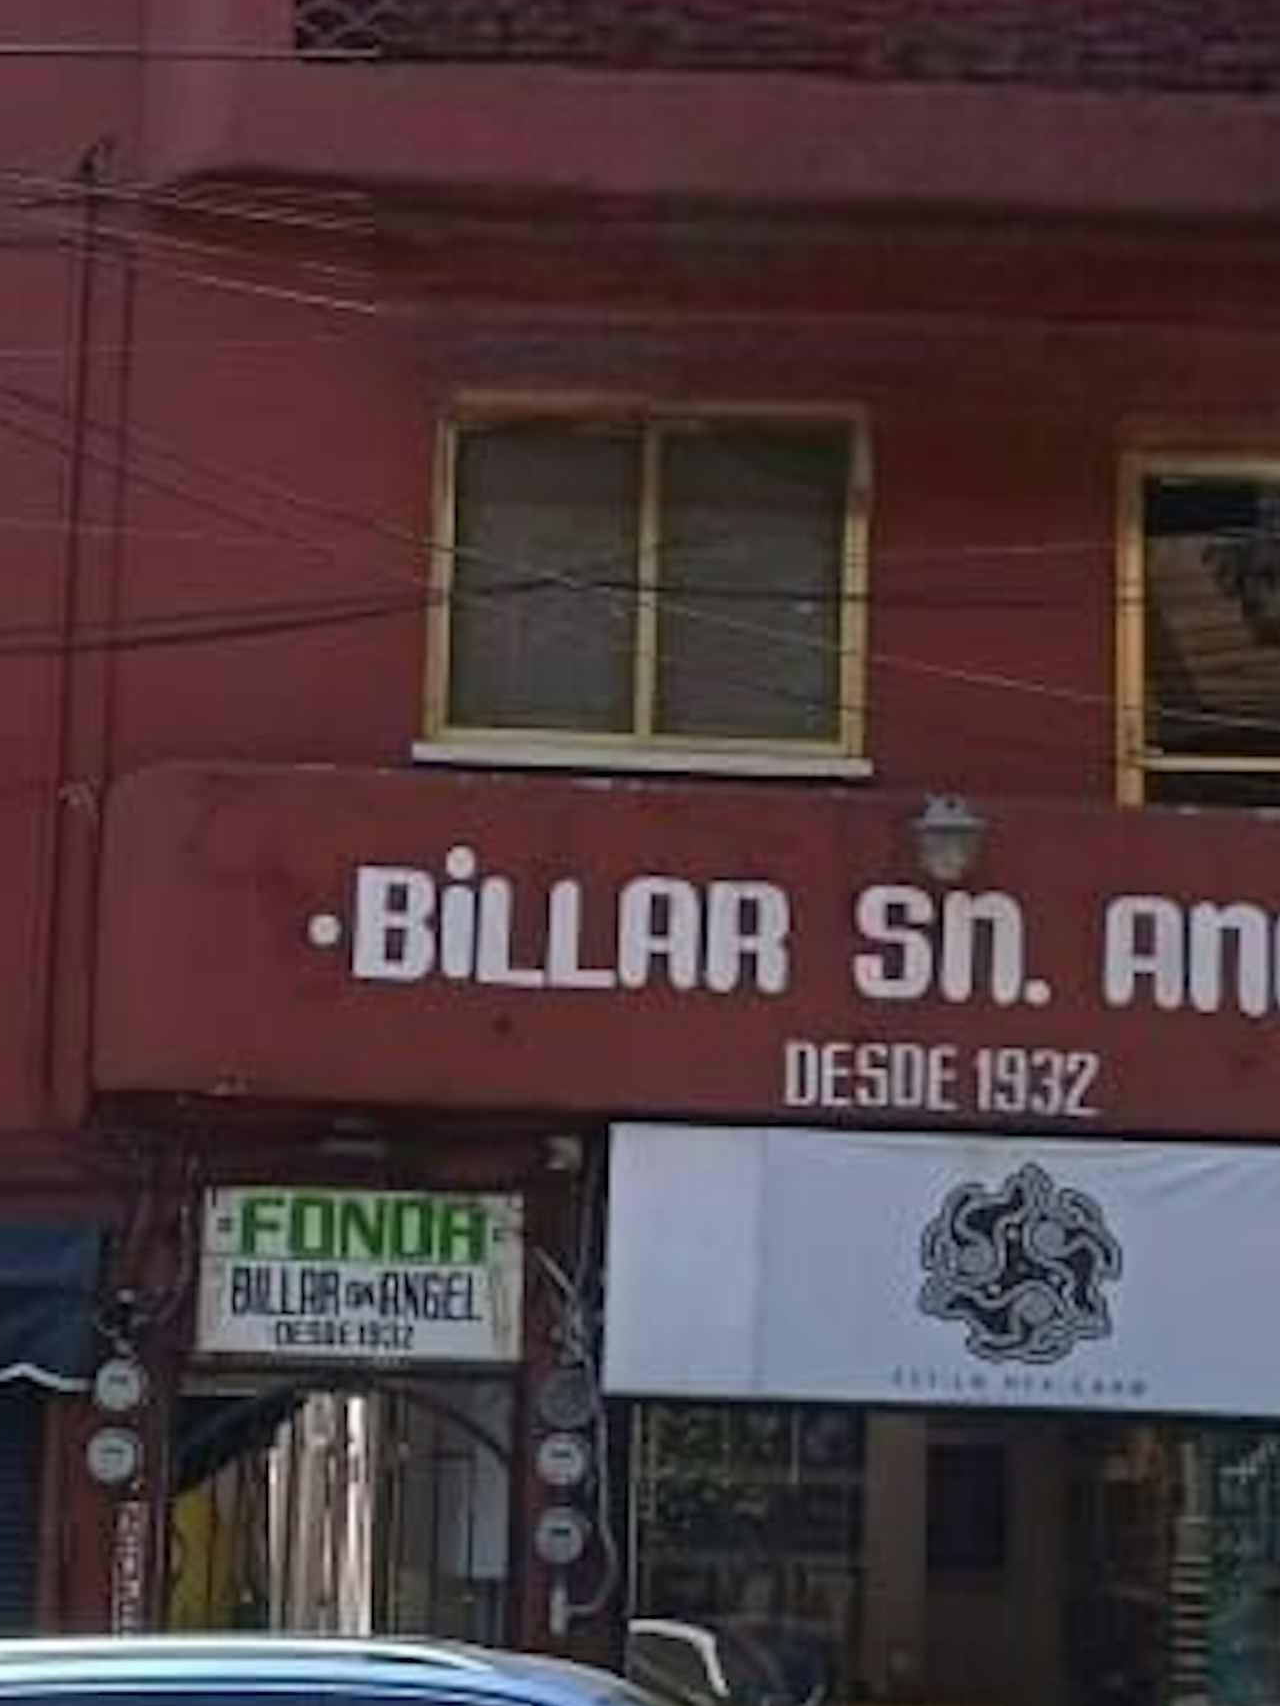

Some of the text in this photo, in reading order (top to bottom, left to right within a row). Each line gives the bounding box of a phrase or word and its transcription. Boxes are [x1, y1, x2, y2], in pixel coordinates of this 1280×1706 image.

[784, 1040, 1099, 1117] DESDE 1932
[239, 1195, 486, 1264] FONDA
[232, 1267, 339, 1317] BILLAR
[378, 1270, 483, 1322] ANGEL
[358, 1321, 414, 1350] 1932
